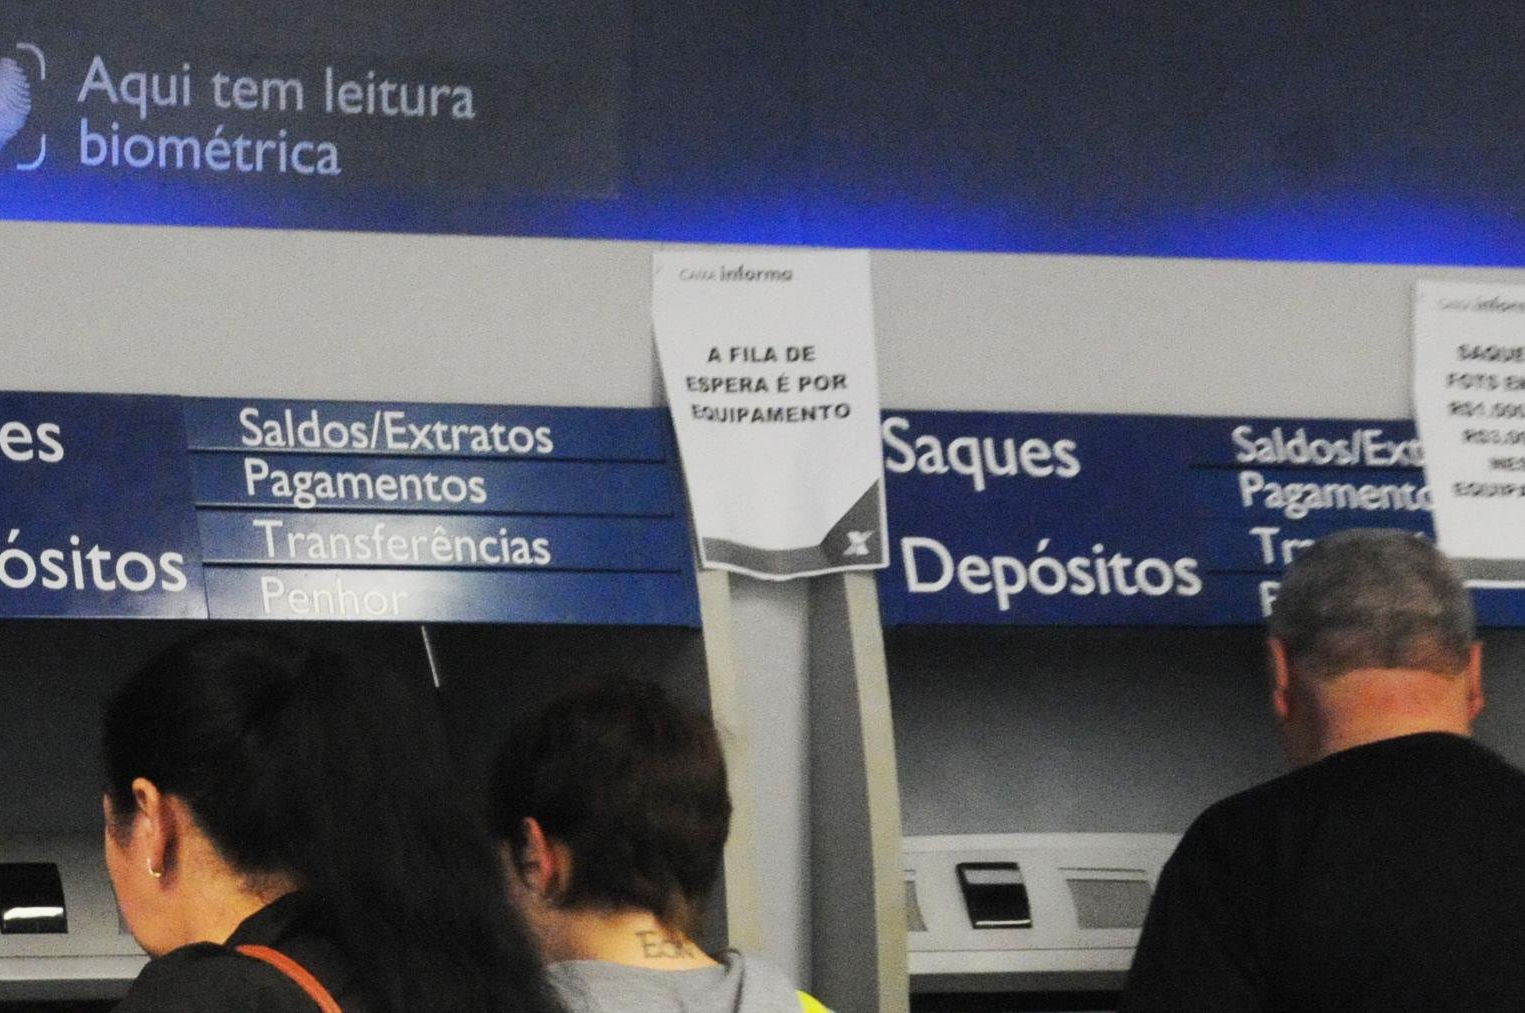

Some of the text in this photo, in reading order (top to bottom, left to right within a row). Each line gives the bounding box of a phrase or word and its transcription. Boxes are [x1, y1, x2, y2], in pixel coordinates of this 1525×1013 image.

[77, 55, 477, 120] Aqui tem leitura
[79, 117, 342, 175] biométrica
[720, 265, 793, 282] informa
[707, 345, 816, 363] A FILA DE
[686, 372, 848, 394] ESPERA É POR
[239, 407, 554, 454] Saldos/Extratos
[691, 403, 852, 424] EQUIPAMENTO
[882, 416, 1081, 492] Saques
[244, 457, 488, 509] Pagamentos
[252, 519, 551, 565] Transferências
[260, 575, 409, 615] Penhor
[901, 536, 1202, 611] Depósitos
